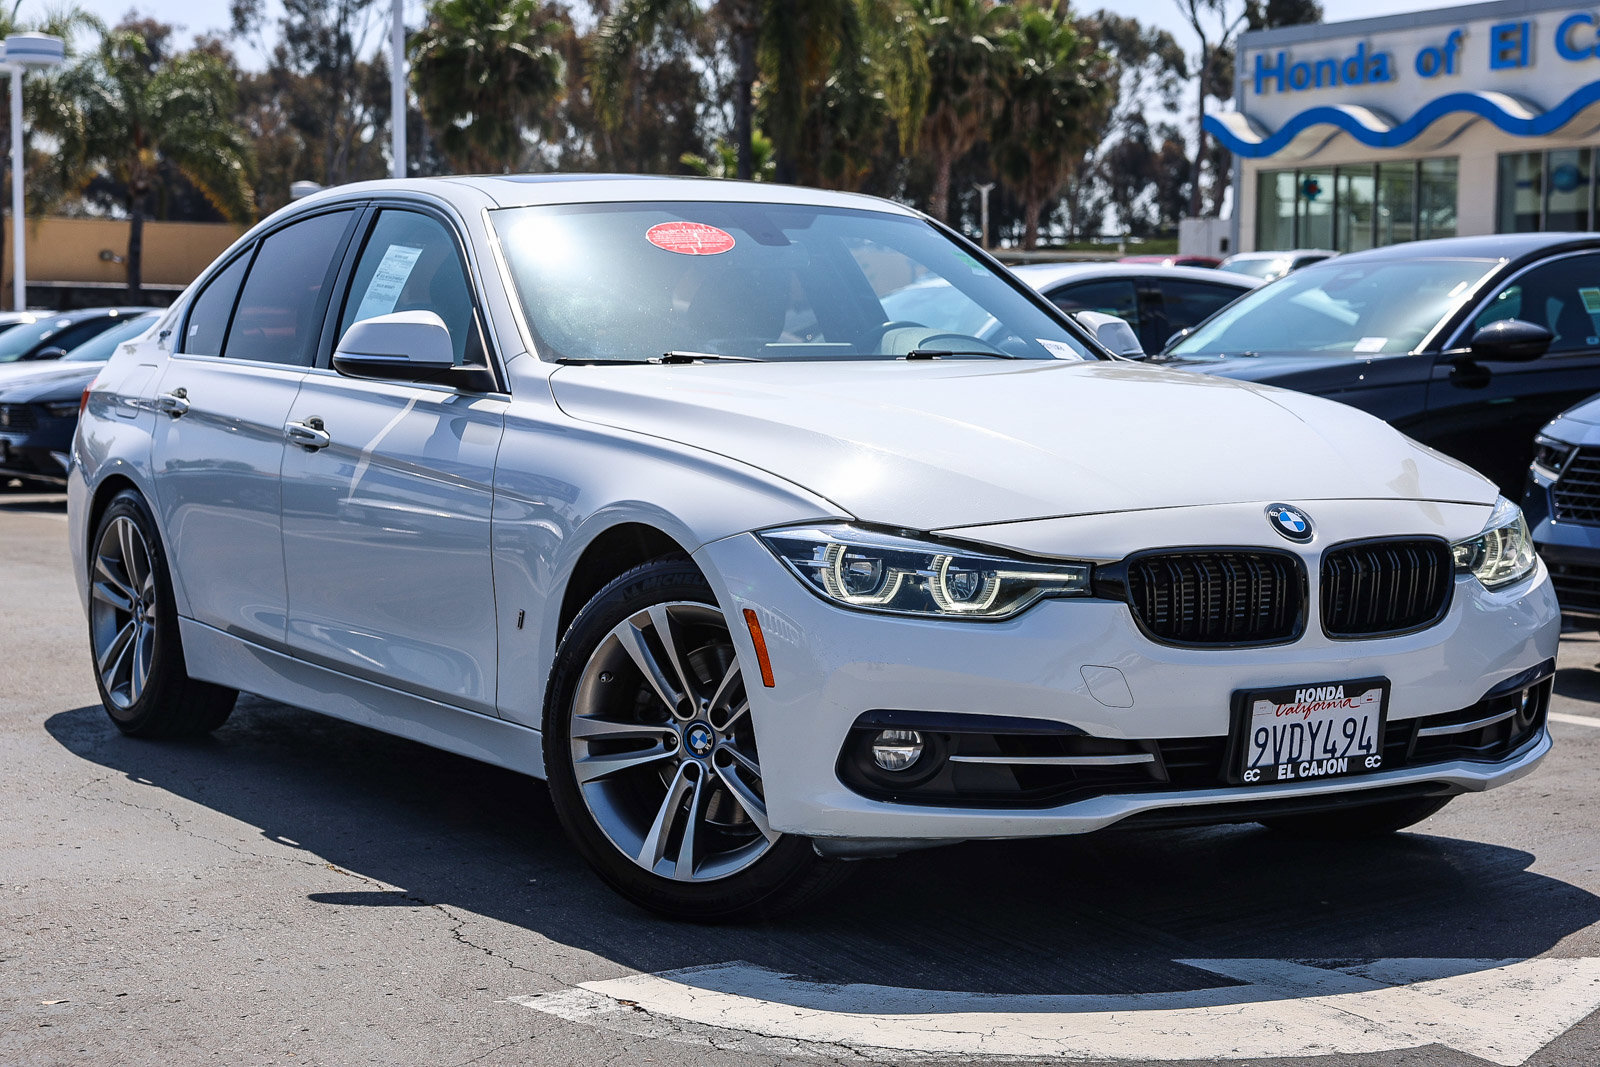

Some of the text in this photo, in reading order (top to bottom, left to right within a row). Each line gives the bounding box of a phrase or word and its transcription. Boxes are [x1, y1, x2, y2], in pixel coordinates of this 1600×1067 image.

[1254, 13, 1600, 94] Honda of El C
[1294, 685, 1345, 704] HONDA
[1275, 697, 1361, 721] California
[1251, 715, 1373, 767] 9VDY494
[1277, 757, 1349, 780] EL CAJON
